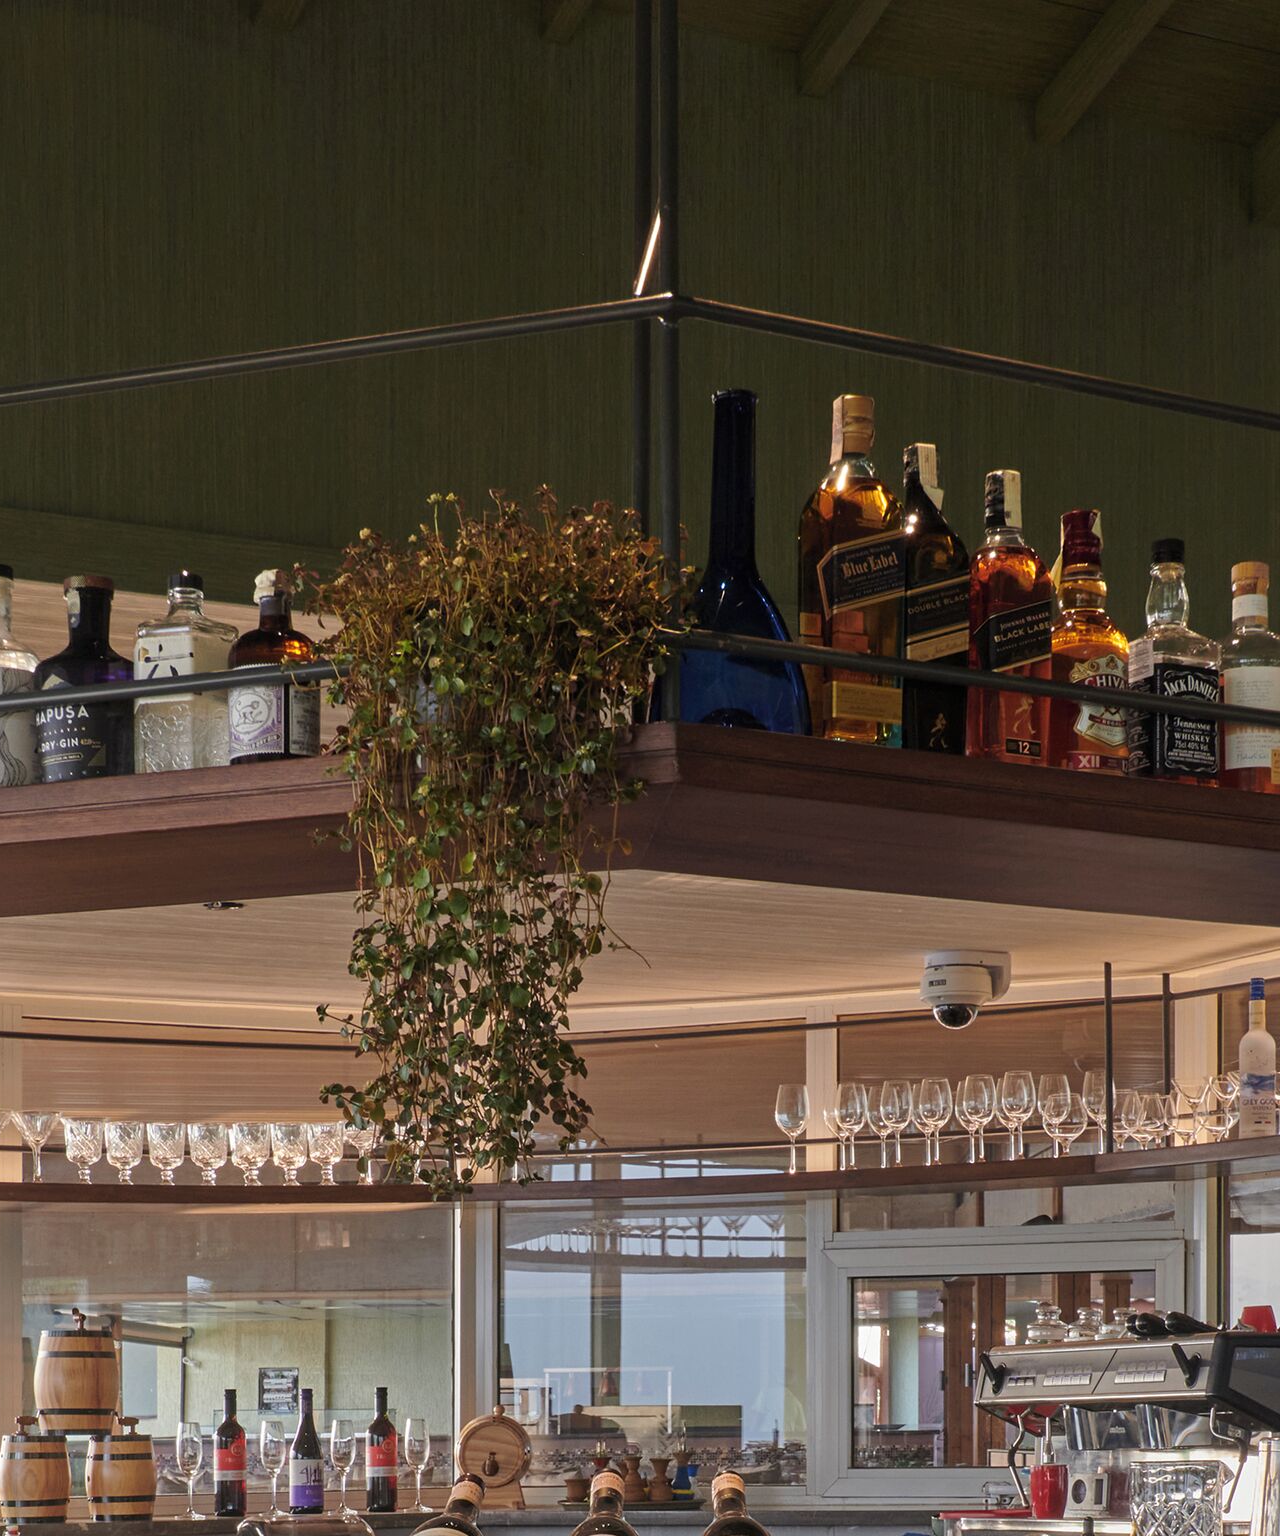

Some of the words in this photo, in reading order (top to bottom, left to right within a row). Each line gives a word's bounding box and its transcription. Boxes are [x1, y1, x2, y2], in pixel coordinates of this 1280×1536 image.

[841, 561, 868, 578] Blue
[869, 552, 899, 573] Label
[908, 599, 941, 615] DOUBLE
[993, 628, 1025, 644] BLACK
[1027, 621, 1052, 634] LABE
[1163, 678, 1187, 697] JACK
[1174, 732, 1210, 743] WHISKEY
[1018, 741, 1031, 754] 12
[1078, 755, 1100, 768] XII
